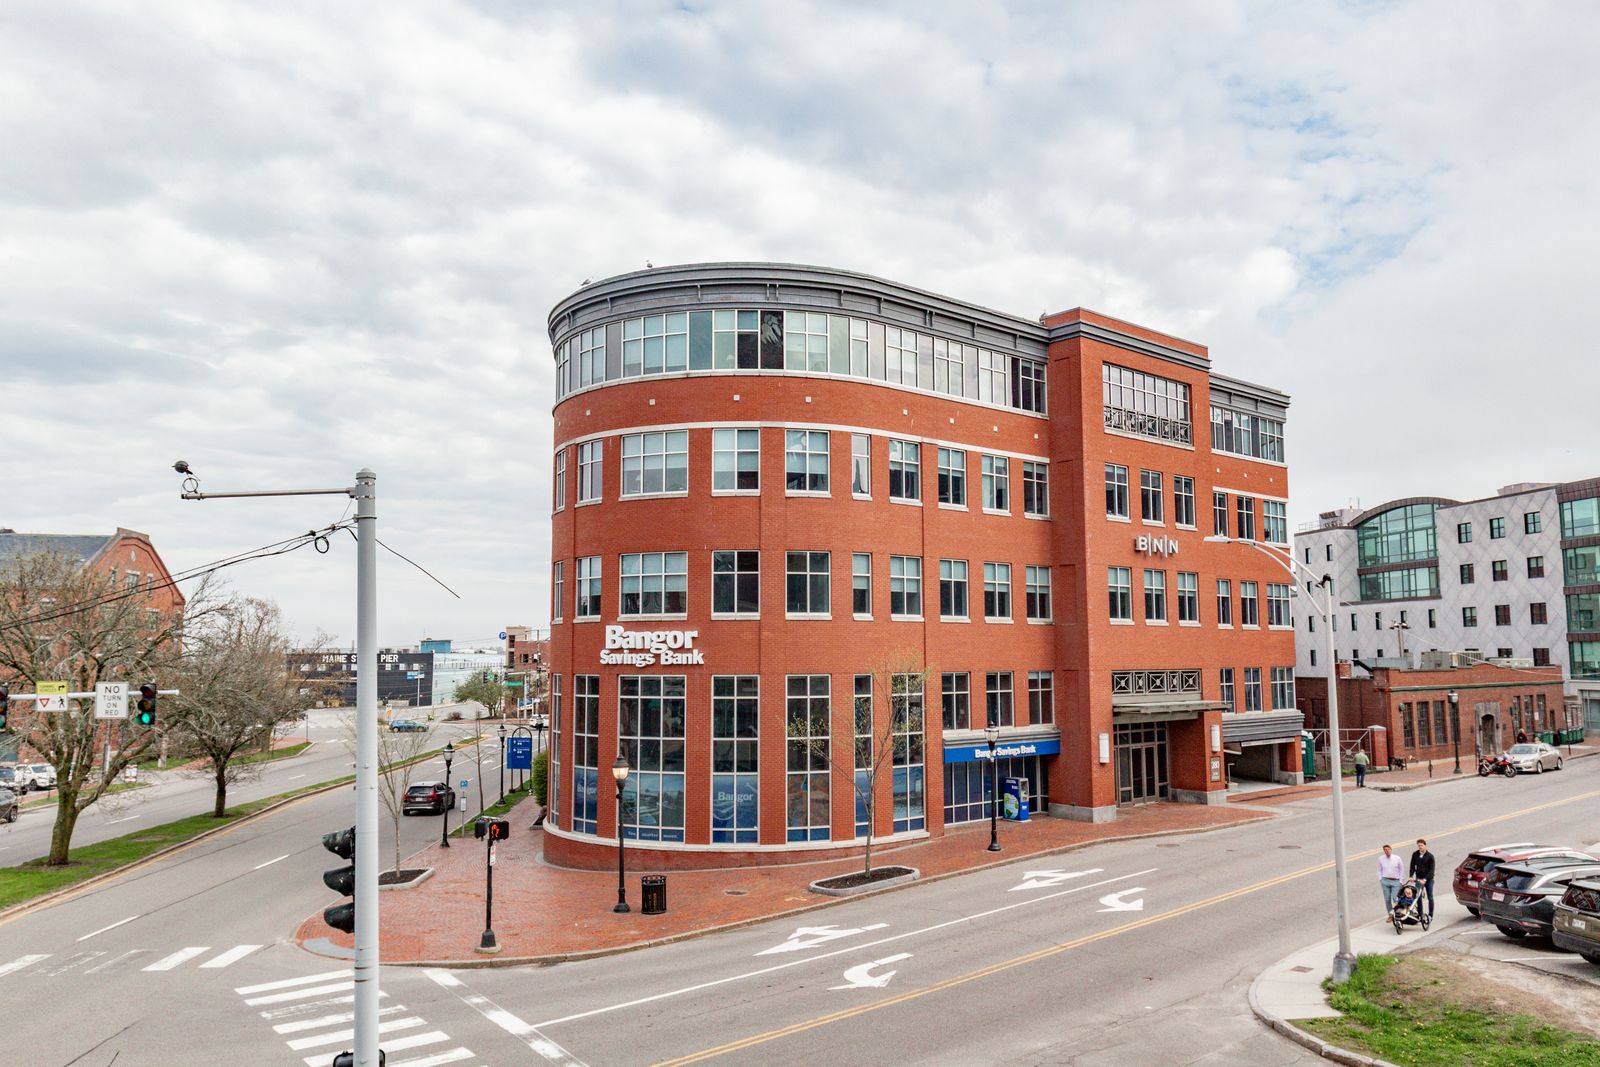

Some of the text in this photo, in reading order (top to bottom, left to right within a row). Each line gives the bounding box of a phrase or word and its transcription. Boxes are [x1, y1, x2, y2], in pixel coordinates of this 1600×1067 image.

[605, 624, 699, 654] Bangor
[322, 654, 347, 663] MAINE
[380, 654, 399, 663] PIER
[600, 649, 704, 667] Savings Bank
[104, 685, 120, 694] NO
[997, 747, 1021, 756] Savings
[1020, 744, 1036, 754] Bank
